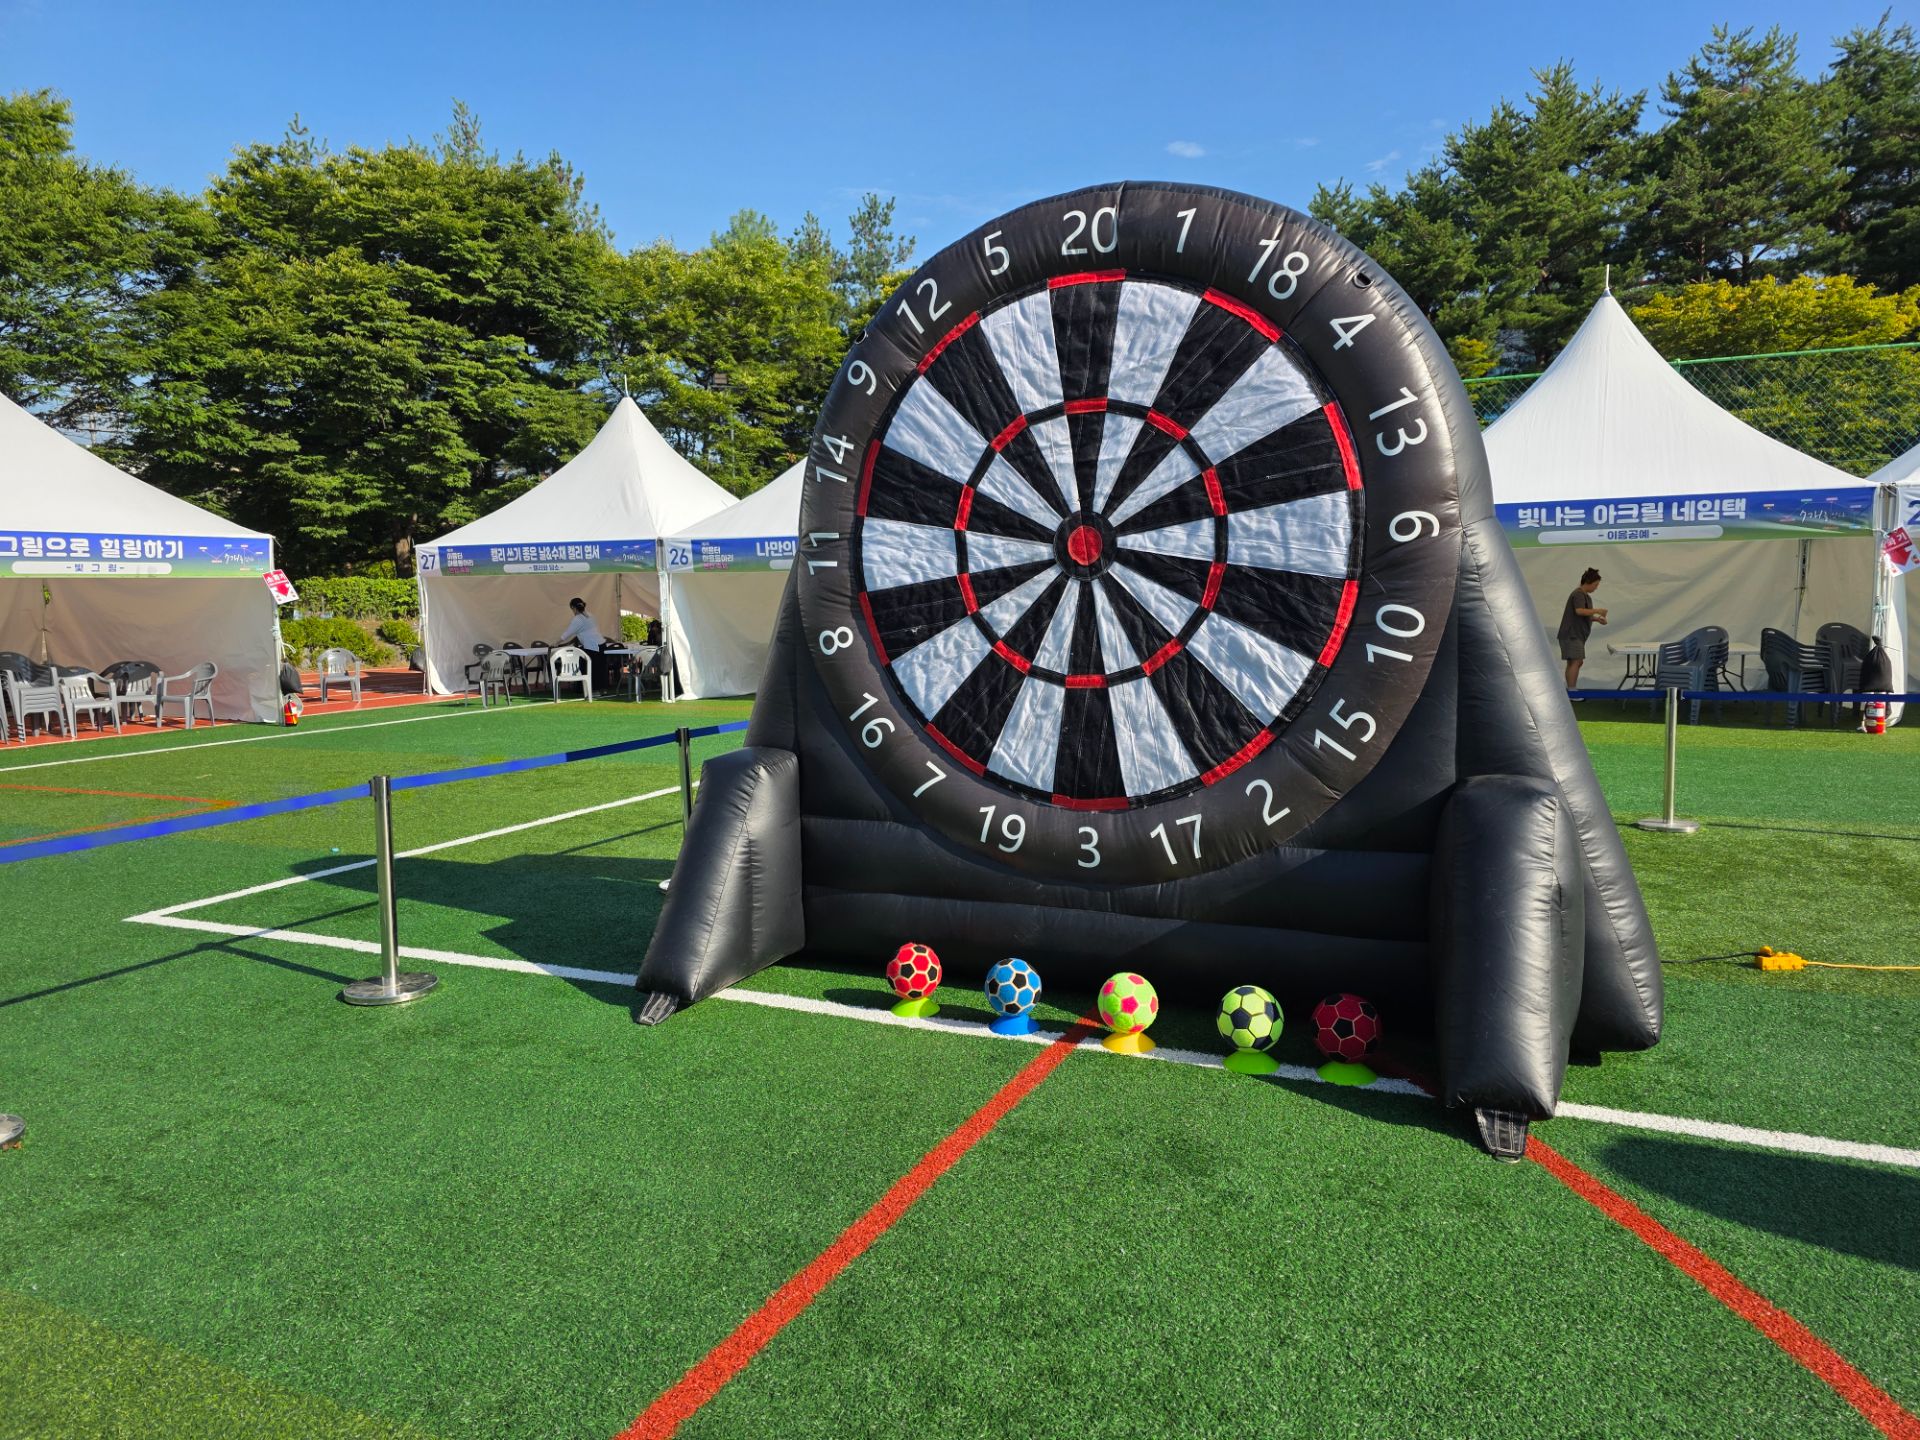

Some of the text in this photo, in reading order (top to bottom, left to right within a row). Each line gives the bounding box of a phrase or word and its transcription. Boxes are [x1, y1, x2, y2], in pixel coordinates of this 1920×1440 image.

[983, 229, 1011, 276] 5
[1061, 204, 1119, 256] 20
[1176, 207, 1197, 253] 1
[1247, 238, 1310, 299] 18
[895, 277, 953, 335] 12
[1329, 311, 1377, 350] 4
[847, 360, 877, 396] 9
[1368, 385, 1430, 457] 13
[815, 434, 855, 484] 14
[1517, 497, 1747, 528] 빛나는 아크릴 네임택
[0, 536, 184, 559] 그림으로 힐링하기
[420, 554, 436, 570] 27
[507, 547, 522, 561] 쓰기
[522, 546, 538, 561] 좋은
[584, 544, 600, 560] 엽서
[670, 548, 689, 565] 26
[756, 540, 796, 557] 나만의
[807, 532, 840, 575] 11
[819, 625, 855, 656] 8
[1365, 603, 1426, 664] 10
[849, 691, 896, 748] 16
[1313, 698, 1377, 763] 15
[912, 760, 948, 798] 7
[1245, 779, 1291, 826] 2
[978, 804, 1027, 853] 19
[1077, 826, 1102, 868] 3
[1149, 813, 1203, 865] 17
